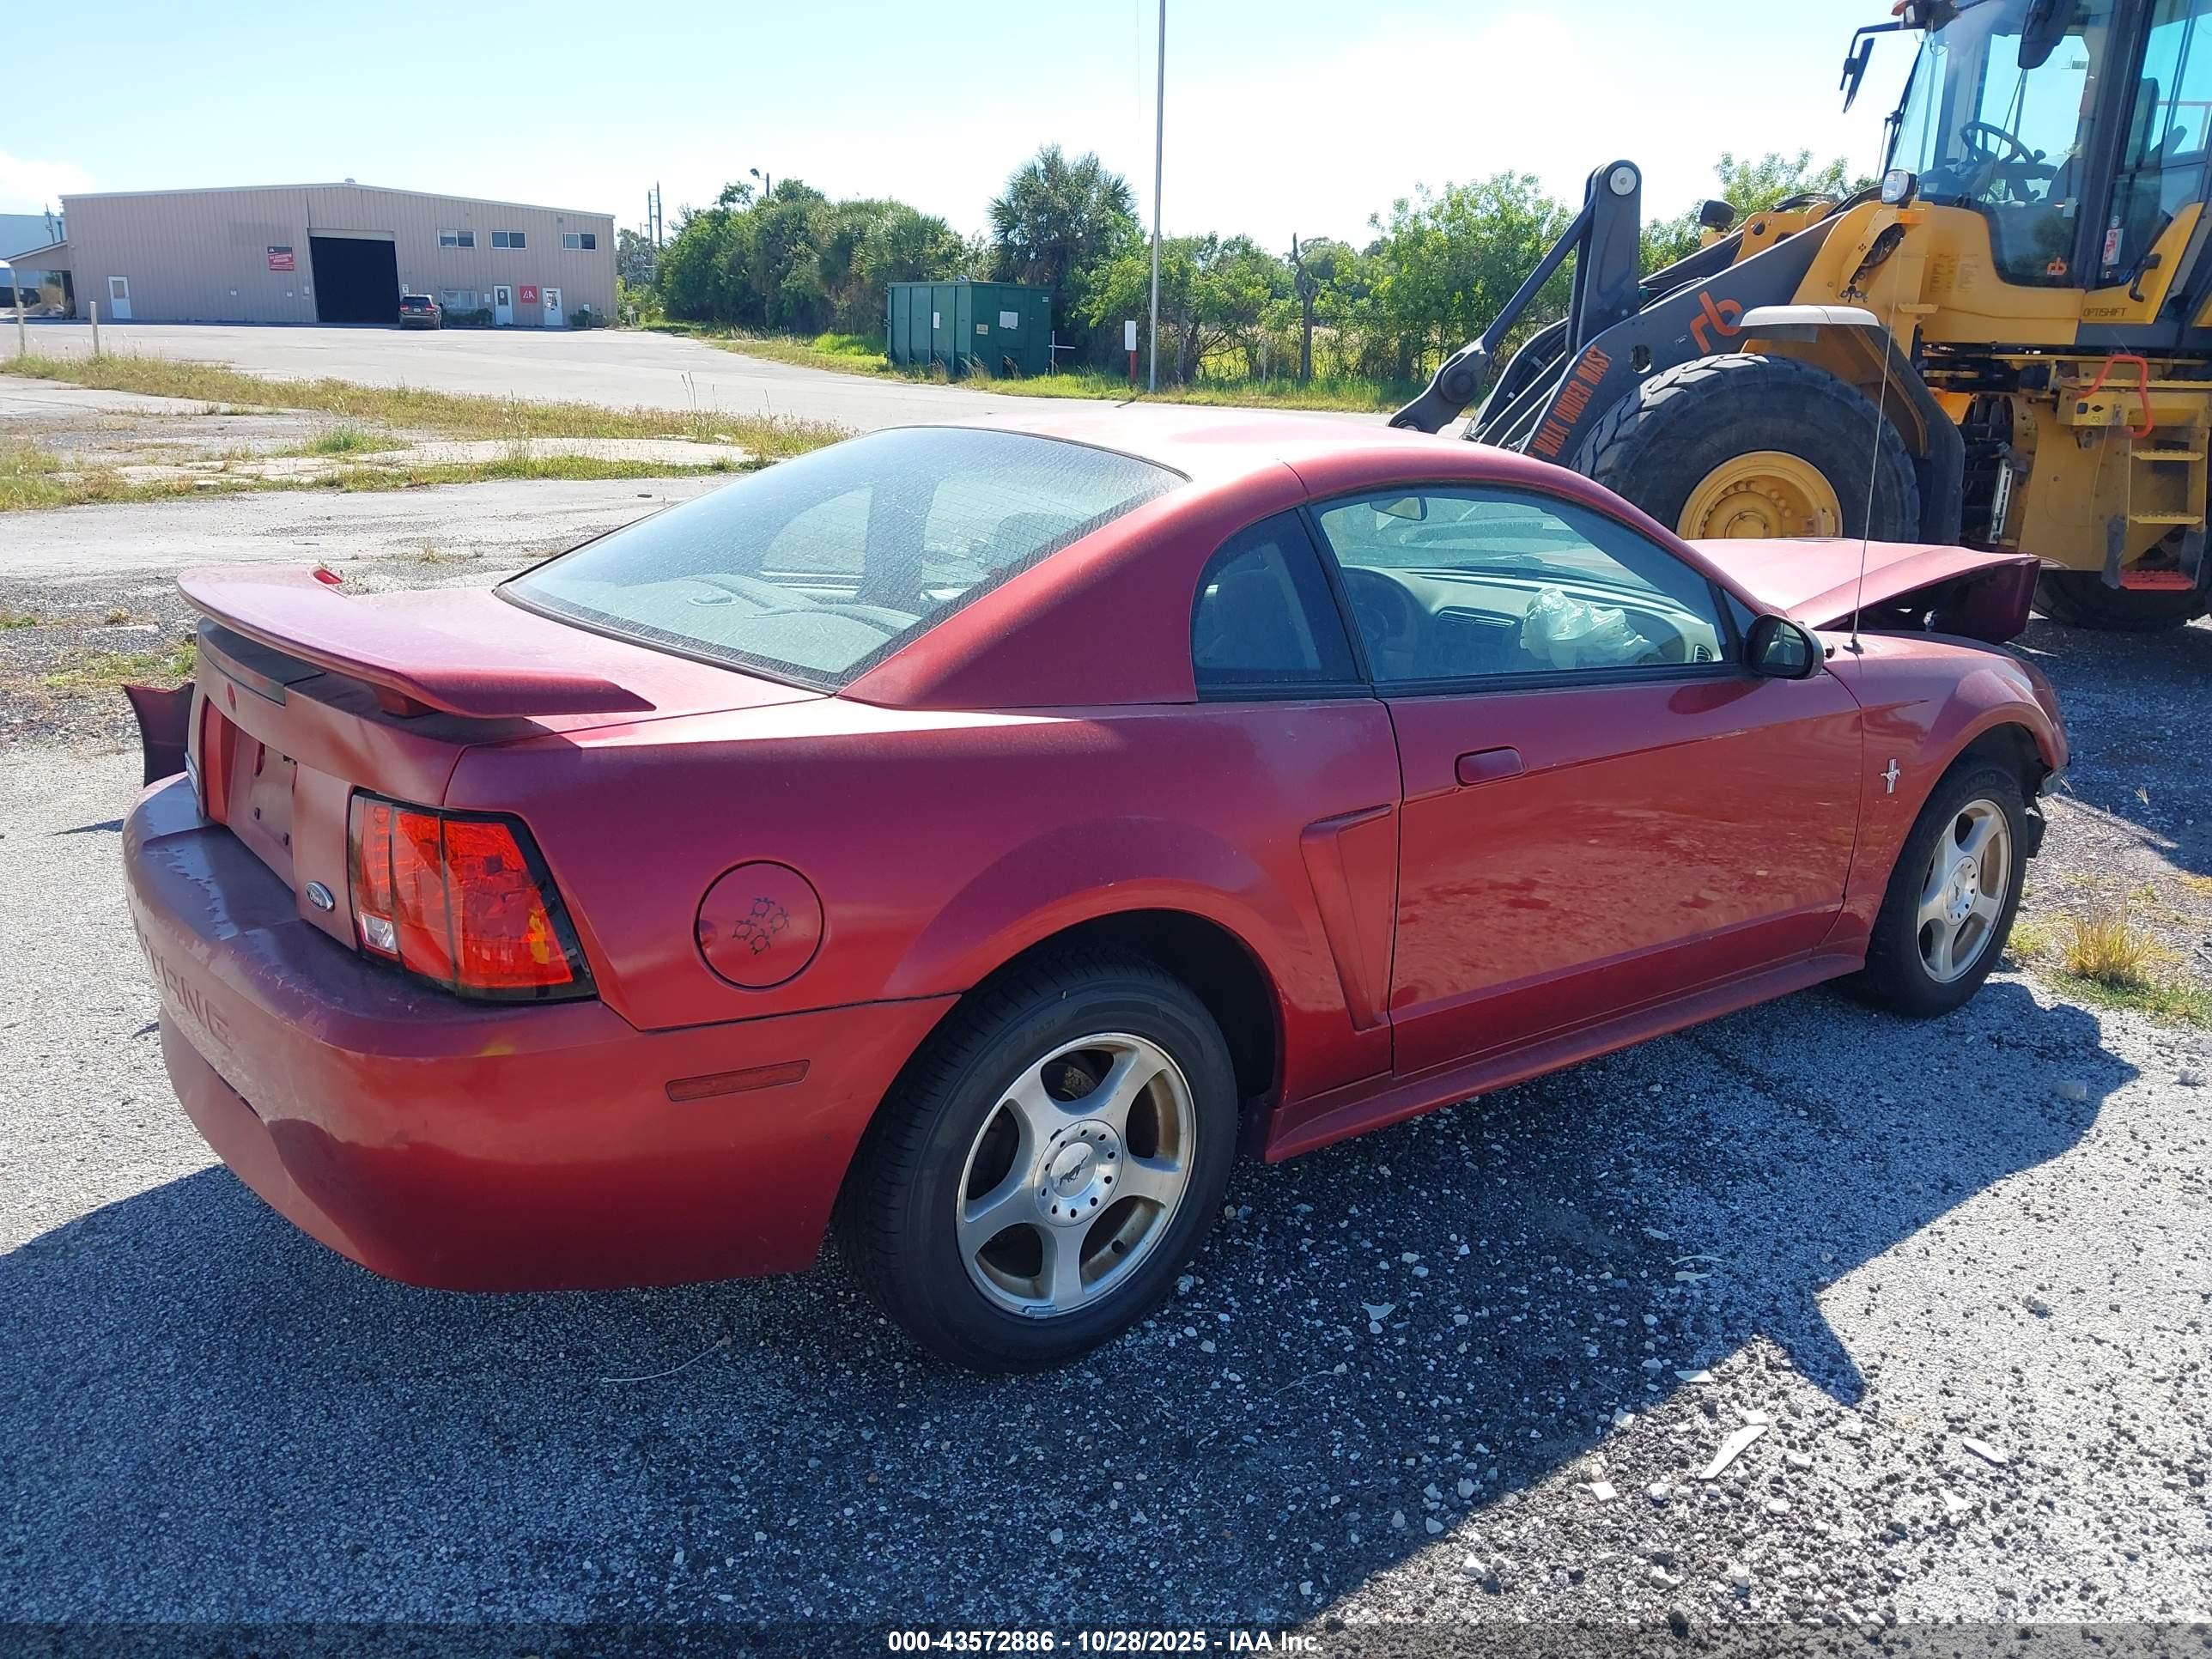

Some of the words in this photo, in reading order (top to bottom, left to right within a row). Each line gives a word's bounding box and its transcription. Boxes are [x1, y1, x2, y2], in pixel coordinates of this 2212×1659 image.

[2082, 307, 2126, 317] OPTISHIFT
[1533, 418, 1571, 458] WALK
[1553, 380, 1594, 425] UNDER
[1575, 343, 1613, 386] MAST
